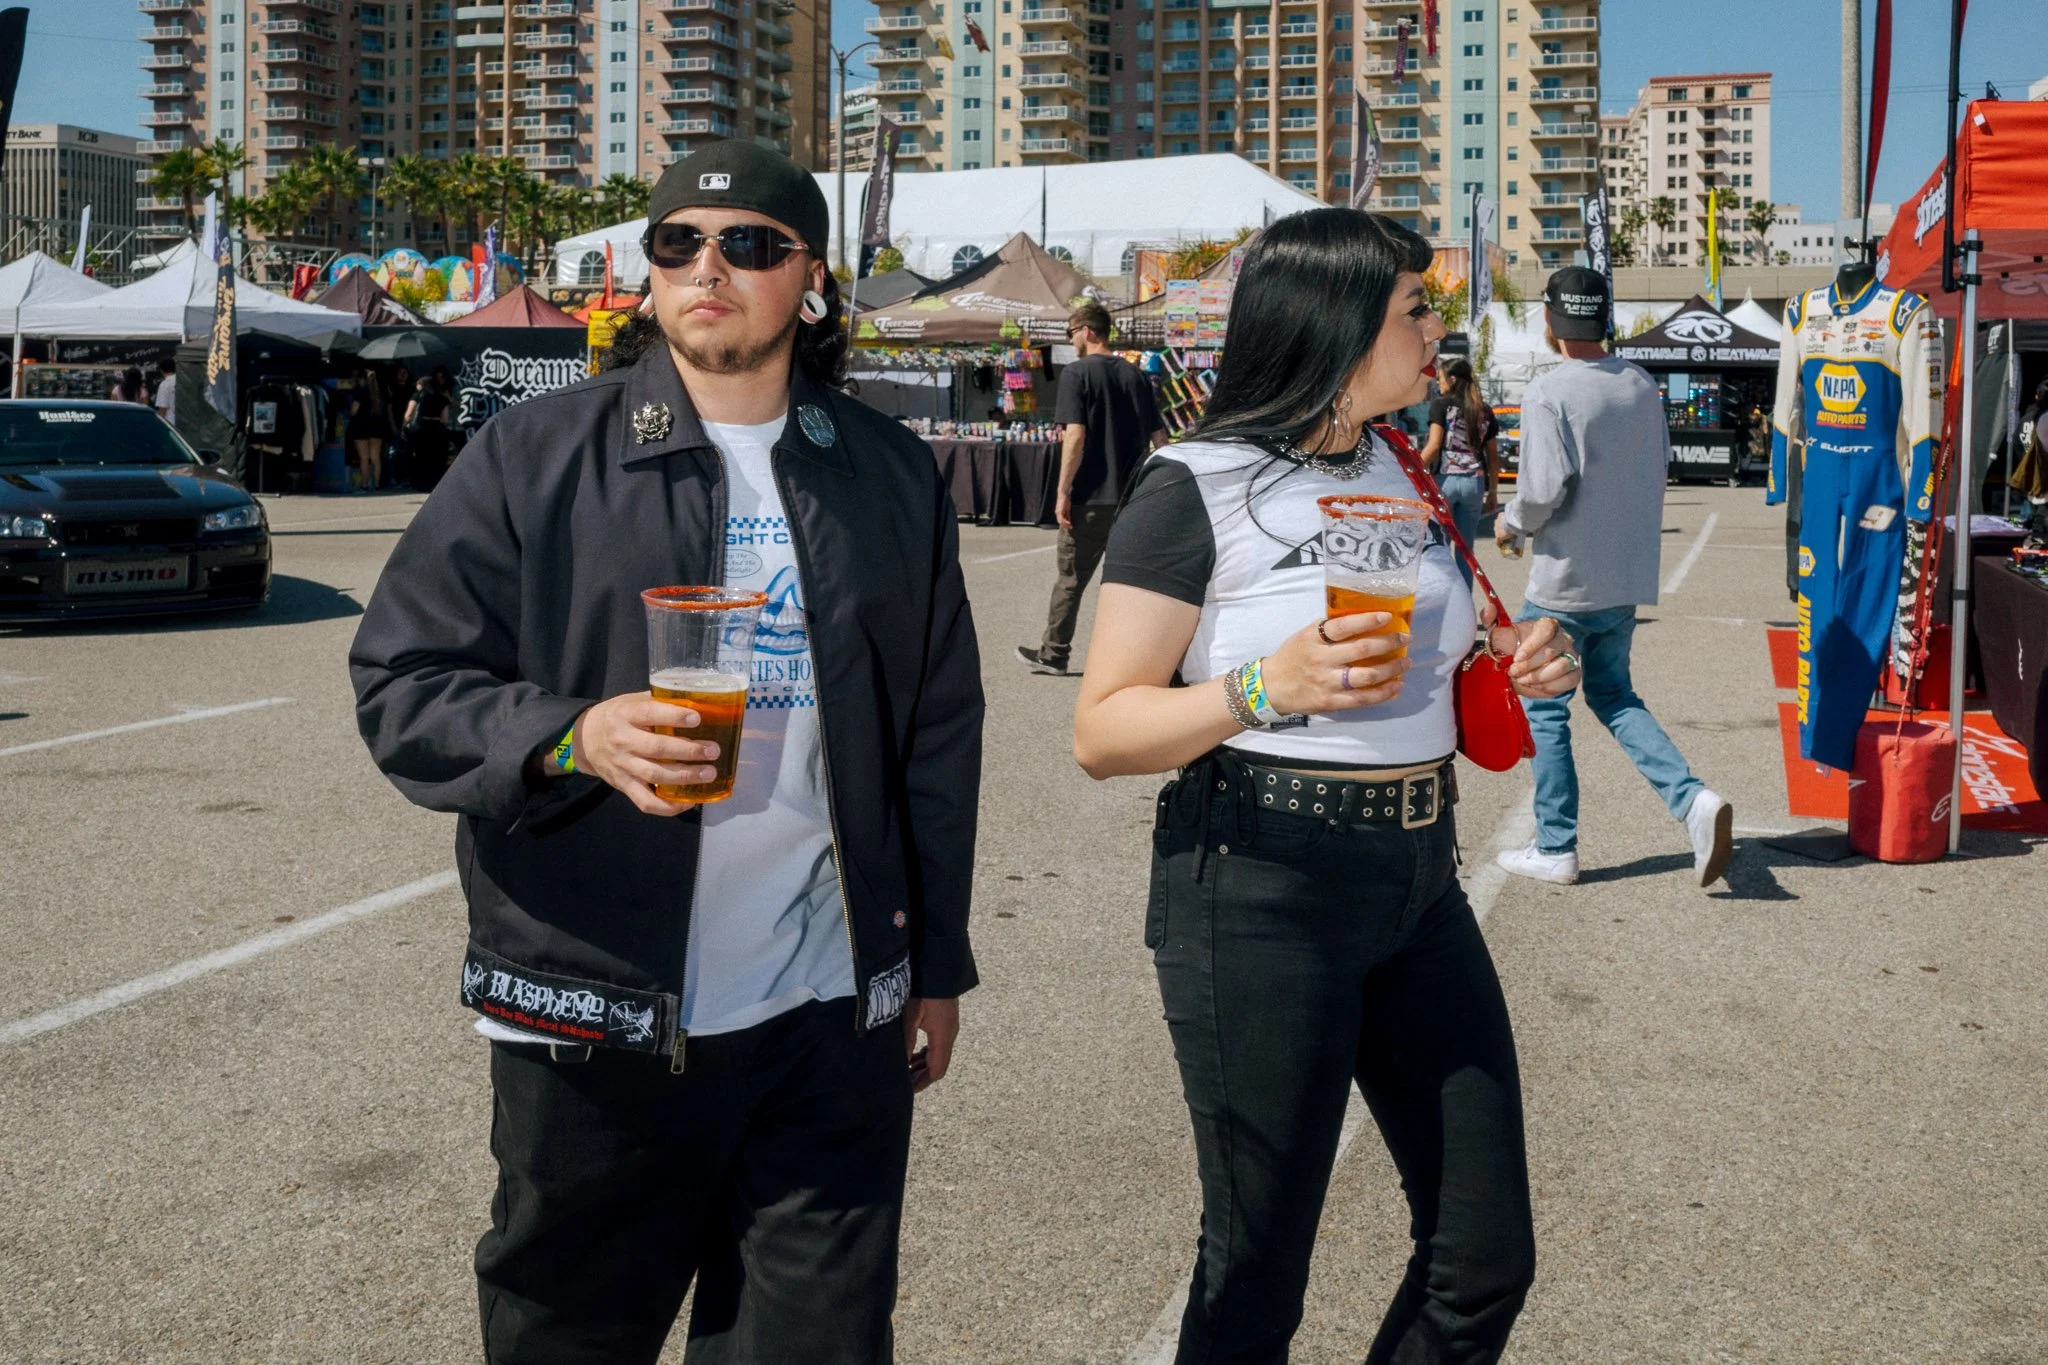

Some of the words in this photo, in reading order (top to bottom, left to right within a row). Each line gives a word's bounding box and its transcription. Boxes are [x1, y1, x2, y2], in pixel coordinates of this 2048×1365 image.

[1561, 293, 1603, 304] MUSTANG
[1615, 346, 1688, 360] HEATWAVE
[1709, 347, 1781, 361] HEATWAVE
[479, 347, 588, 390] Dreamz
[1823, 375, 1857, 400] NAPA
[1816, 410, 1838, 423] AUTO
[1838, 412, 1867, 425] PARTS
[1820, 442, 1875, 454] ELLIOTT
[725, 533, 769, 545] GHT
[773, 533, 789, 544] C
[77, 568, 177, 584] nismo
[1798, 591, 1812, 653] AUTO
[789, 659, 811, 681] HO
